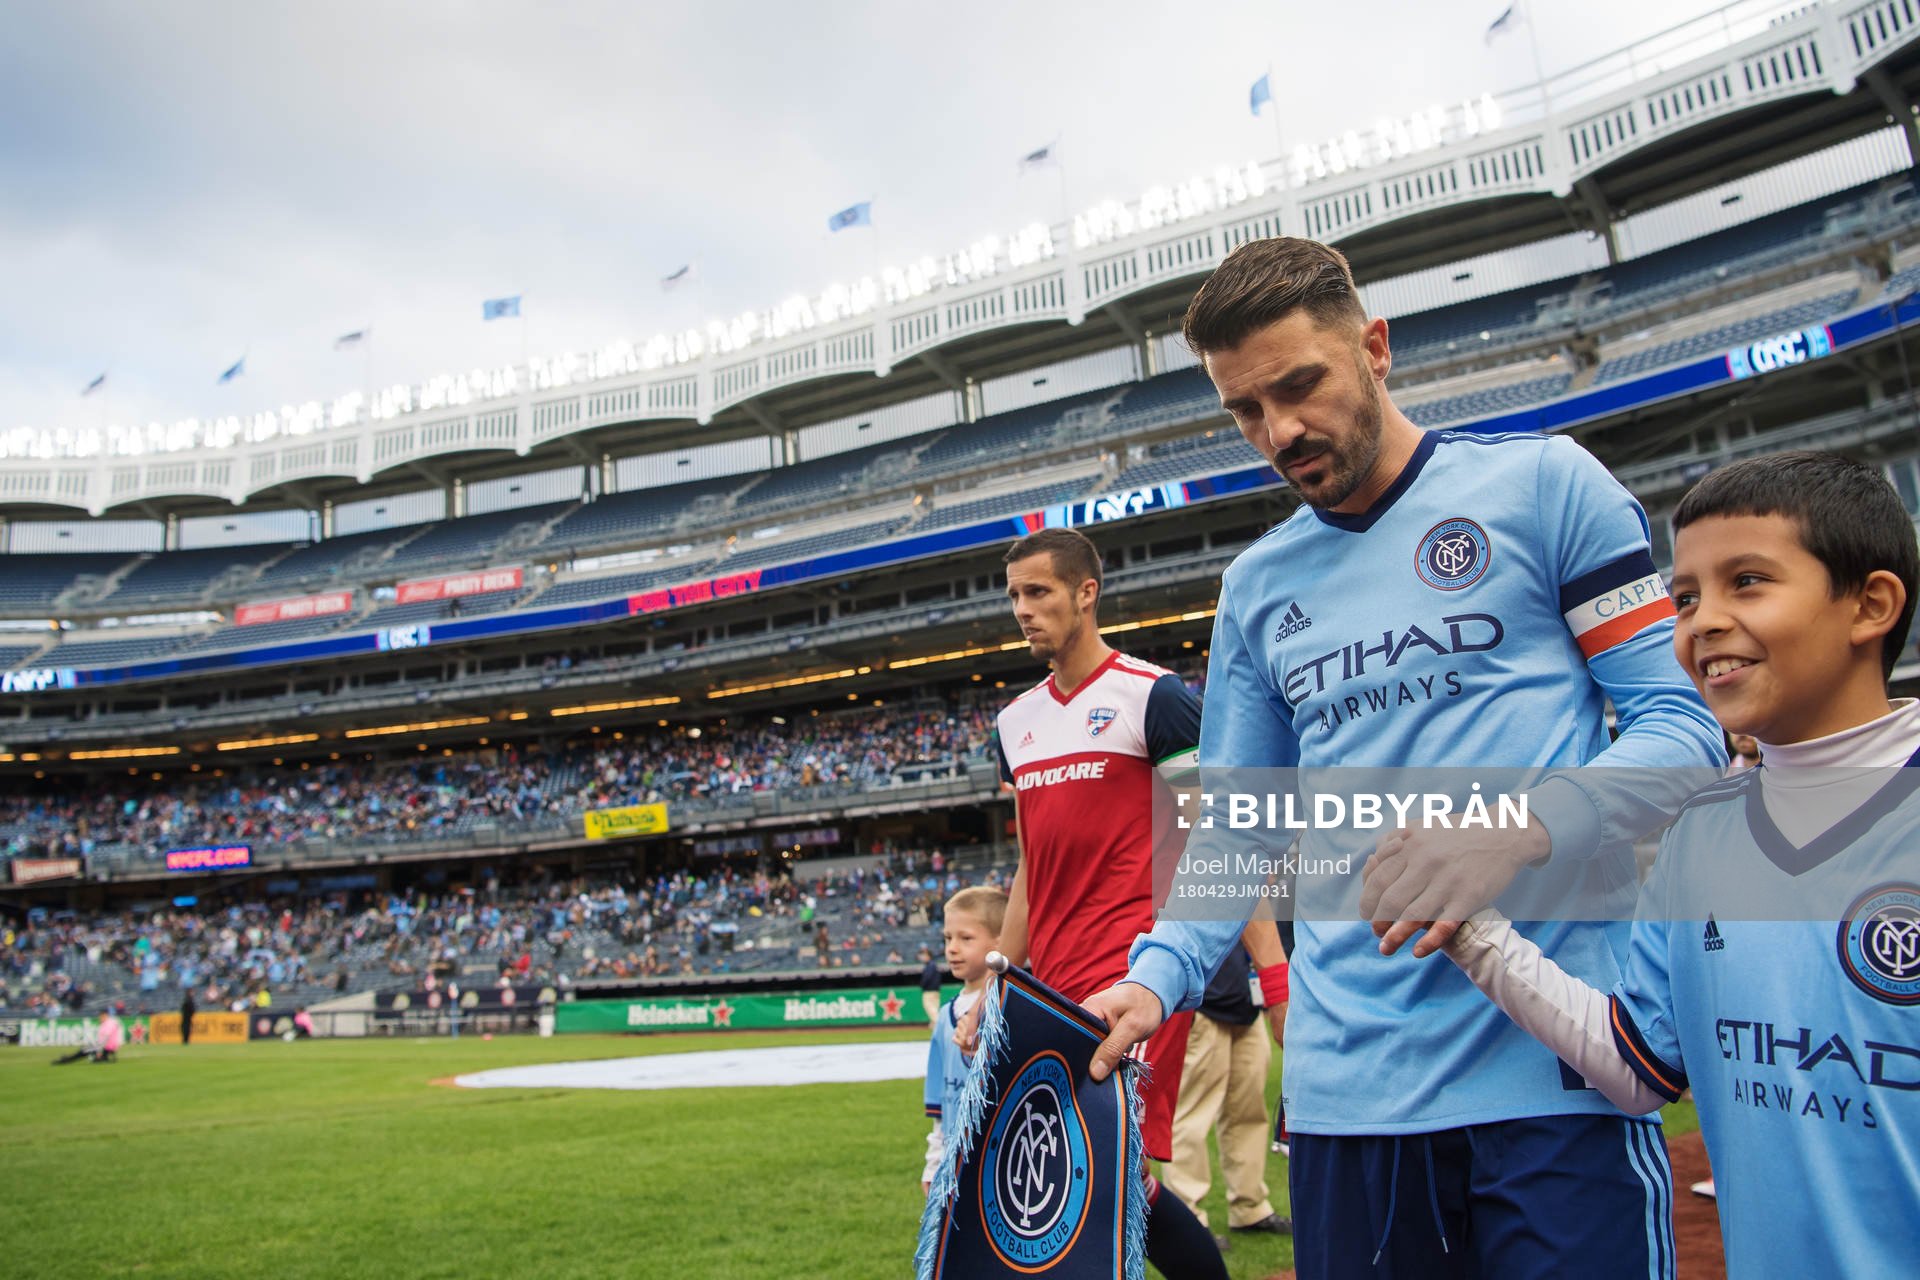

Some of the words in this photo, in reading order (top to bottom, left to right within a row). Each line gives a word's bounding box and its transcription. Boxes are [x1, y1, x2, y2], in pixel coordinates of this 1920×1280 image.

[1428, 529, 1441, 543] NEW
[1442, 523, 1460, 532] YORK
[1460, 523, 1474, 532] CITY
[714, 569, 763, 598] CITY
[1428, 576, 1464, 587] FOOTBALL
[1464, 567, 1480, 582] CLUB
[1275, 617, 1312, 643] adidas
[1284, 613, 1505, 706] ETIHAD
[1319, 671, 1462, 732] AIRWAYS
[1016, 762, 1106, 791] ADVOCARE
[1865, 897, 1886, 912] NEW
[1888, 895, 1917, 904] YORK
[1861, 966, 1912, 992] FOOTBALL
[628, 1003, 708, 1026] Heineken
[784, 997, 876, 1021] Heineken
[20, 1017, 124, 1047] Heinek
[1021, 1066, 1041, 1089] NEW
[1735, 1077, 1878, 1129] AIRWAYS
[987, 1201, 1038, 1258] FOOTBALL
[1040, 1220, 1070, 1254] CLUB
